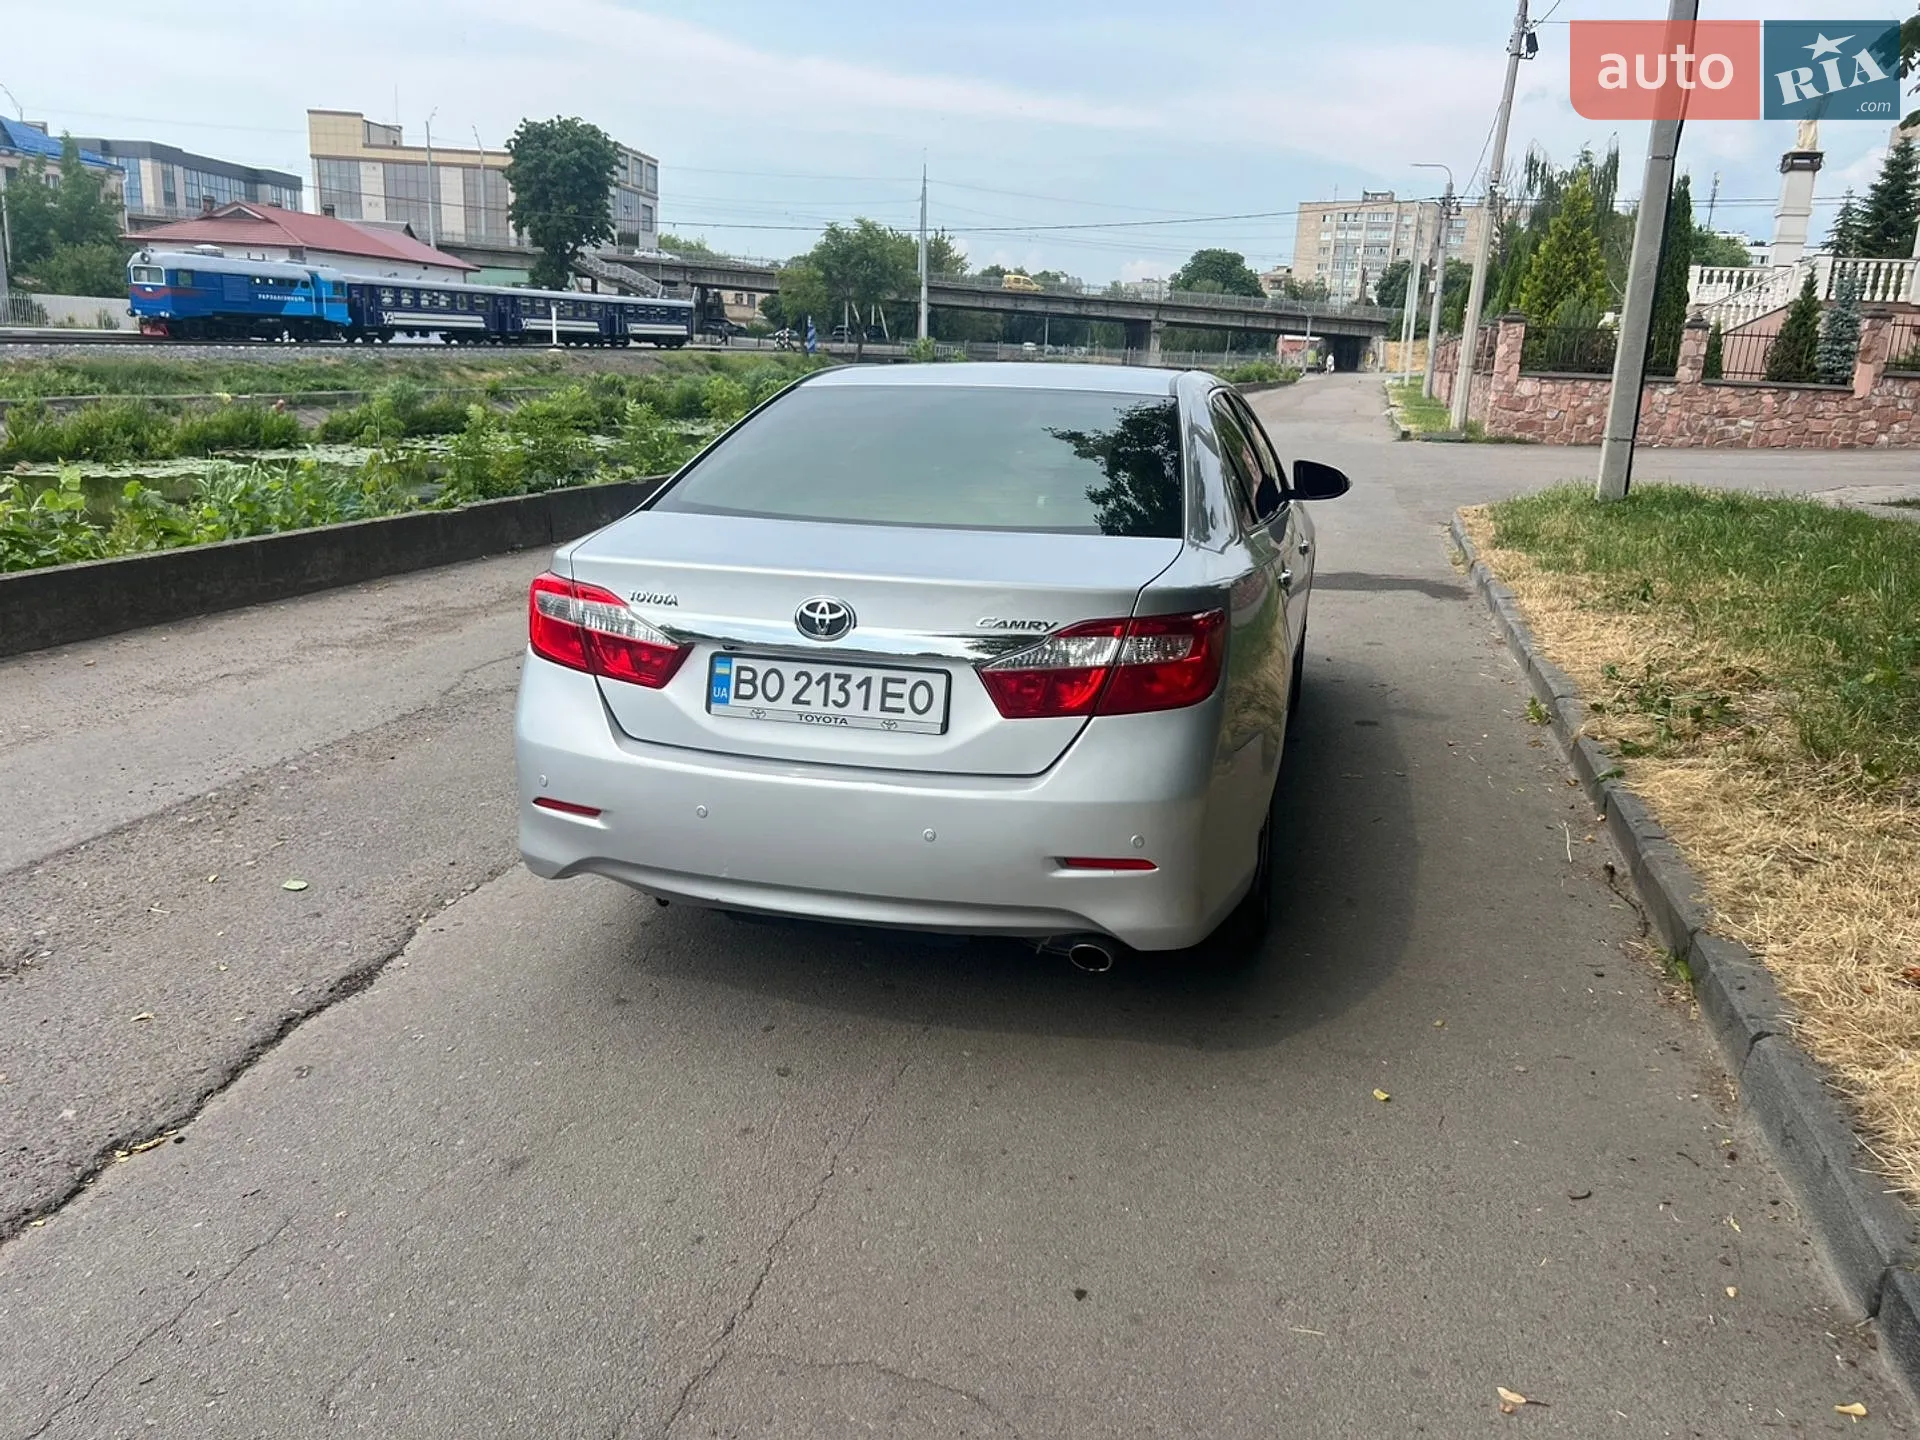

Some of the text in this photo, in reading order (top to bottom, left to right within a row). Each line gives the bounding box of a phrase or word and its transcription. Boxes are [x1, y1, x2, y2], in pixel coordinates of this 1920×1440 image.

[628, 591, 679, 607] TOYOTA
[976, 617, 1059, 632] CAMRY
[713, 686, 728, 698] UA
[733, 665, 934, 715] BO 2131 EO
[797, 713, 848, 726] TOYOTA
